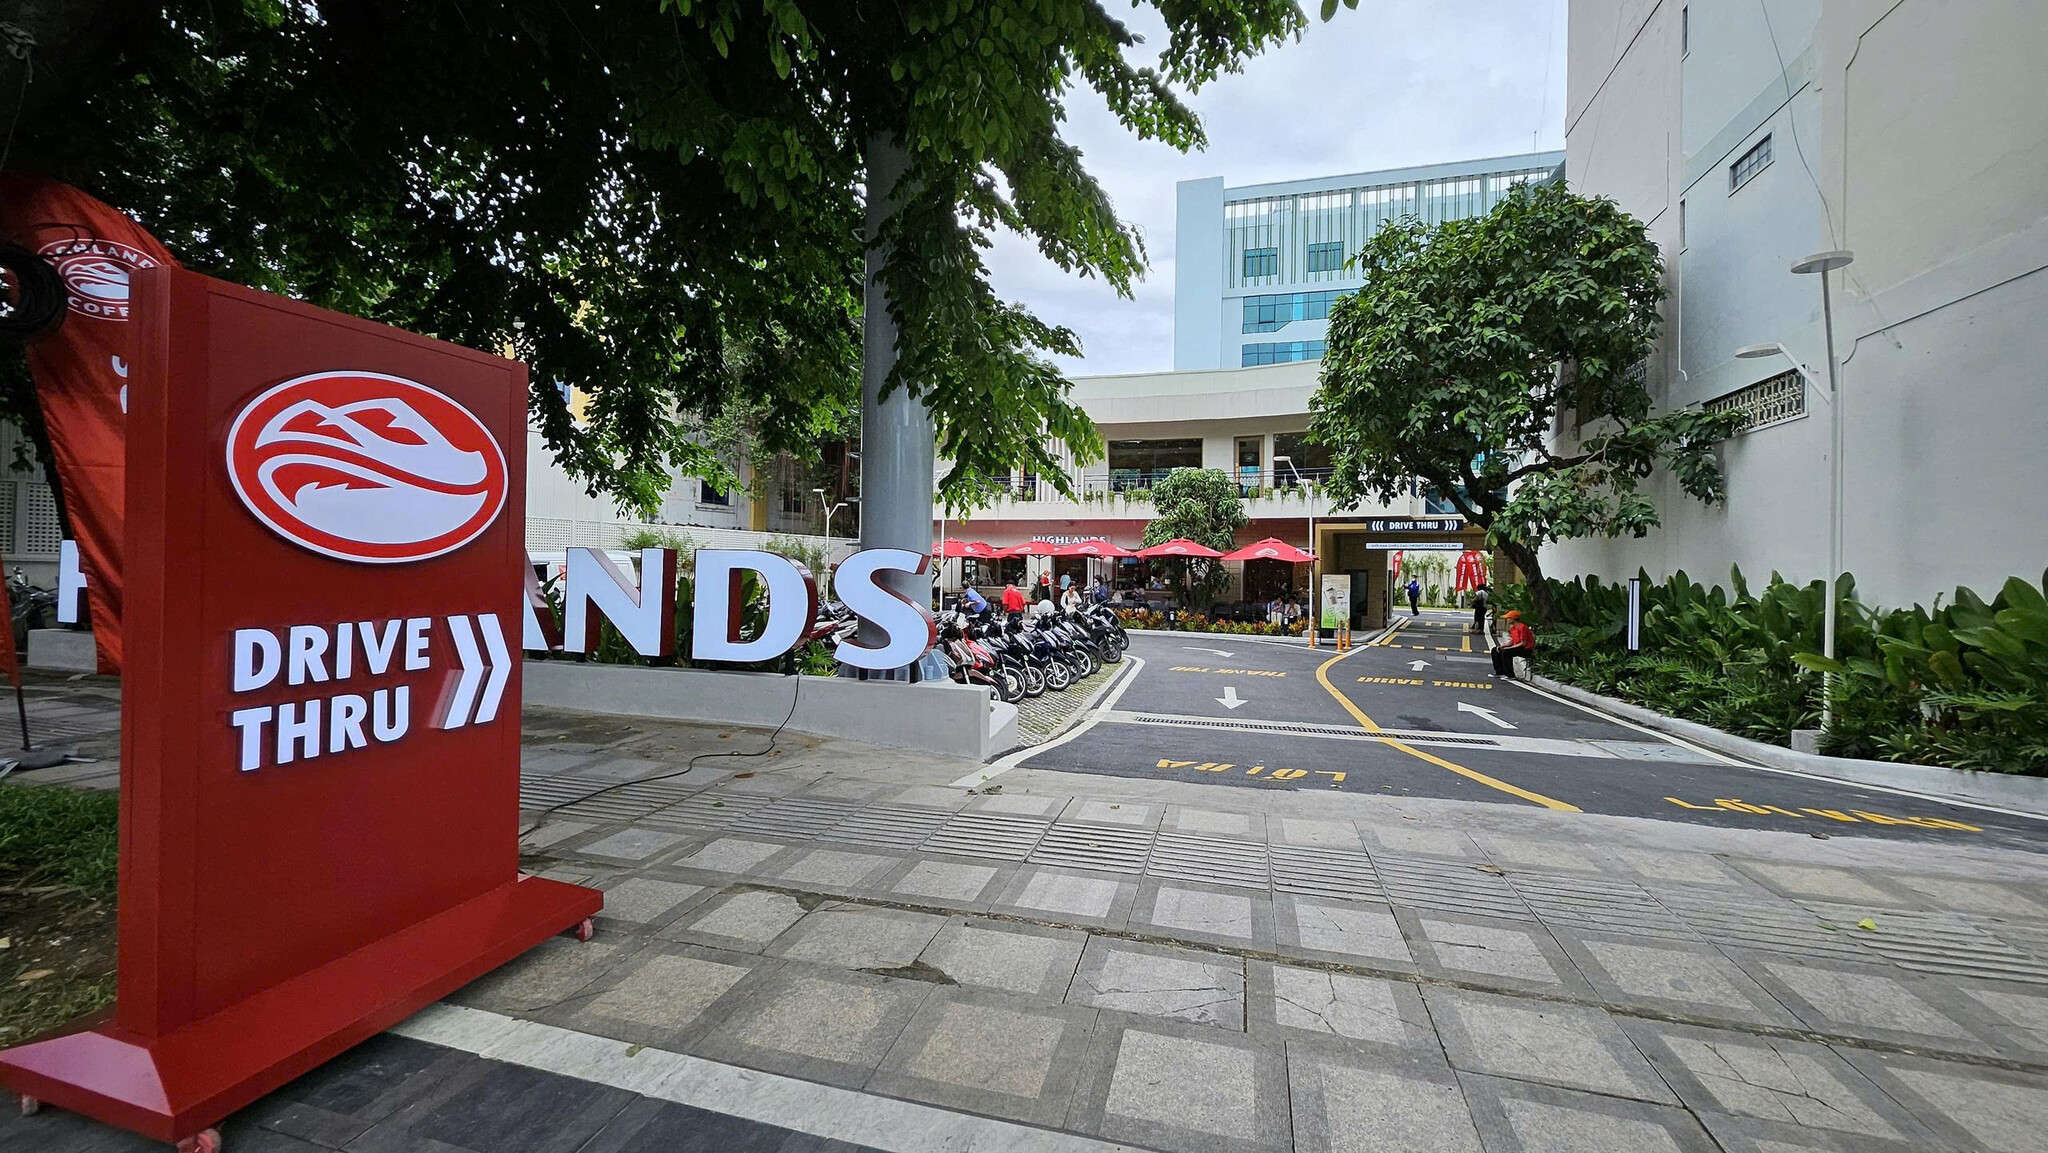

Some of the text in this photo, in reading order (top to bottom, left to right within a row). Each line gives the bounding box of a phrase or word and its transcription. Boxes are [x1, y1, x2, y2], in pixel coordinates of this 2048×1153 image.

[67, 296, 130, 317] COFF
[1389, 521, 1439, 530] DRIVE THRU
[234, 617, 431, 692] DRIVE
[1357, 676, 1493, 690] DRIVE THRU
[233, 685, 409, 771] THRU
[1156, 758, 1237, 773] RA
